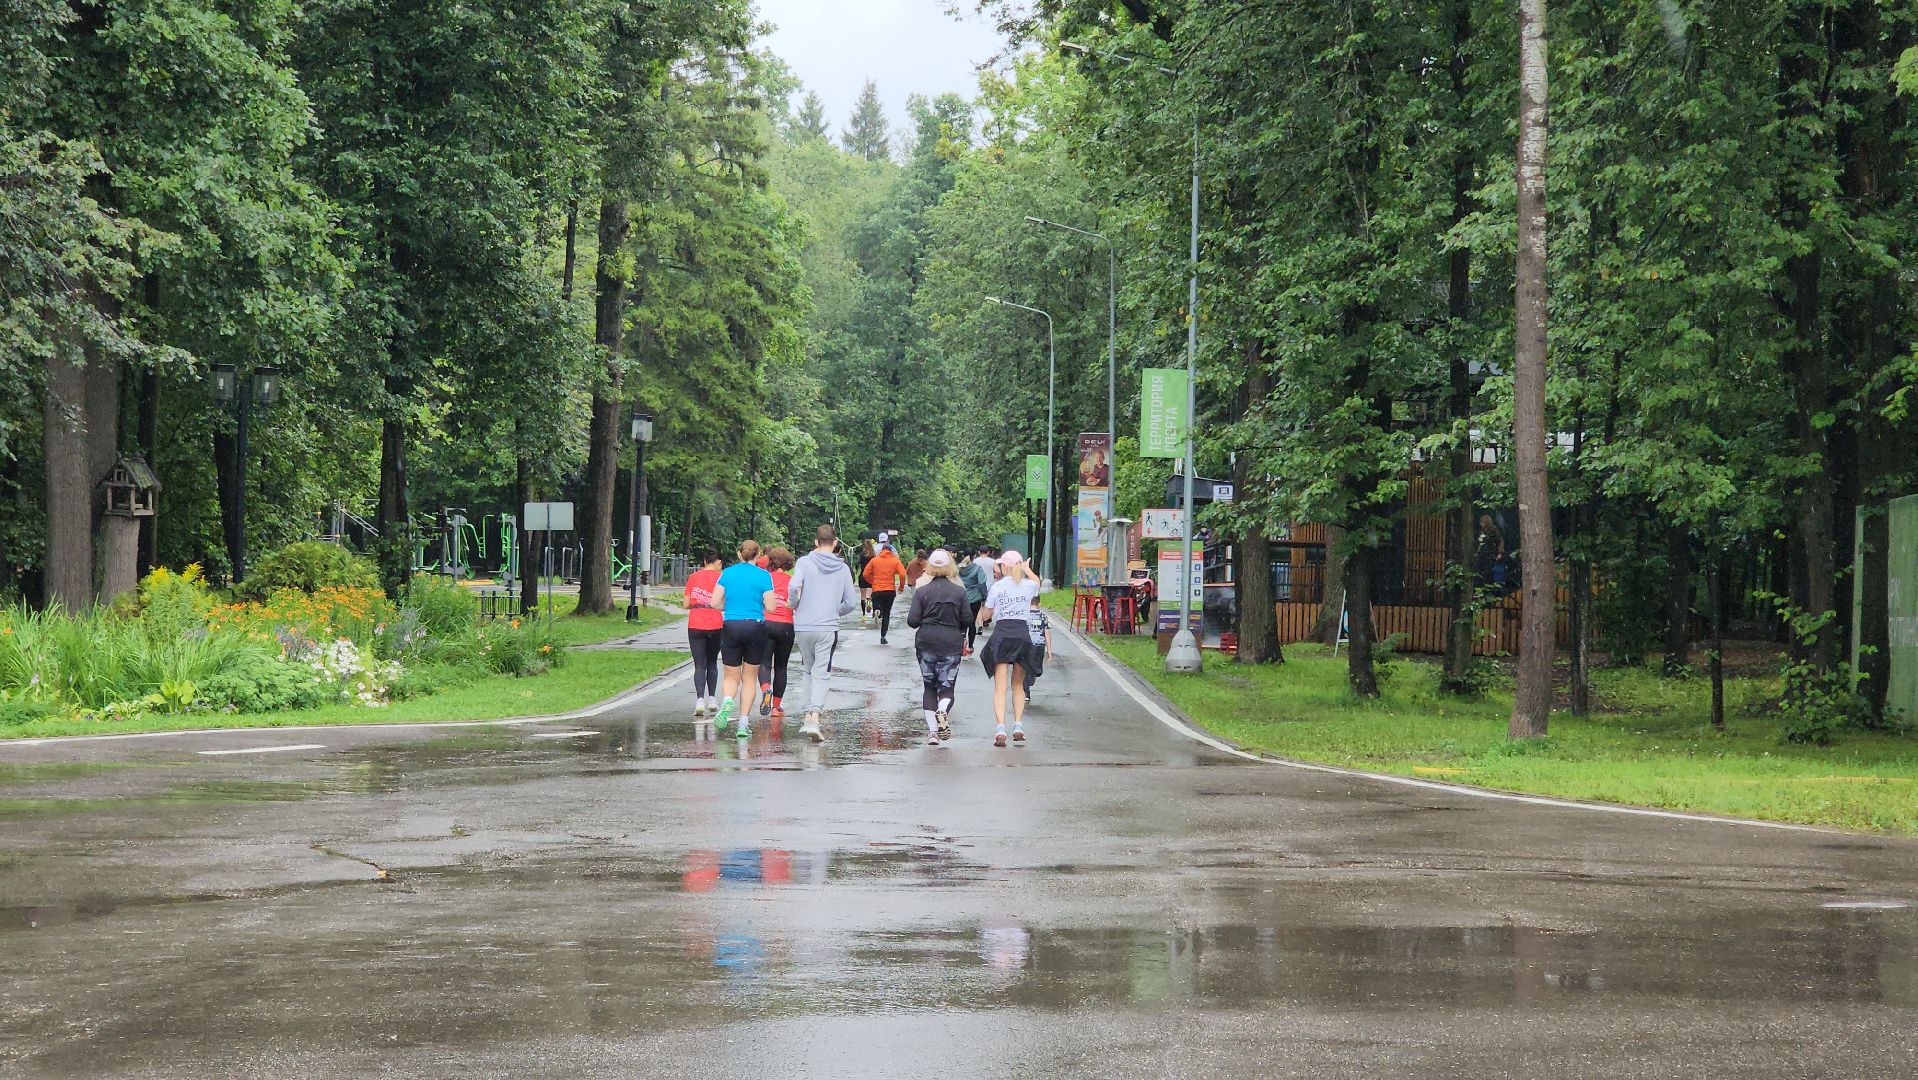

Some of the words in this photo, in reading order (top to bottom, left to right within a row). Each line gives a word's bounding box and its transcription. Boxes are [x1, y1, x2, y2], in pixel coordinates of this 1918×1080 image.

[1149, 375, 1164, 451] ТЕРРИТОРИЯ
[999, 595, 1027, 605] SUPER
[999, 609, 1026, 617] SPORT
